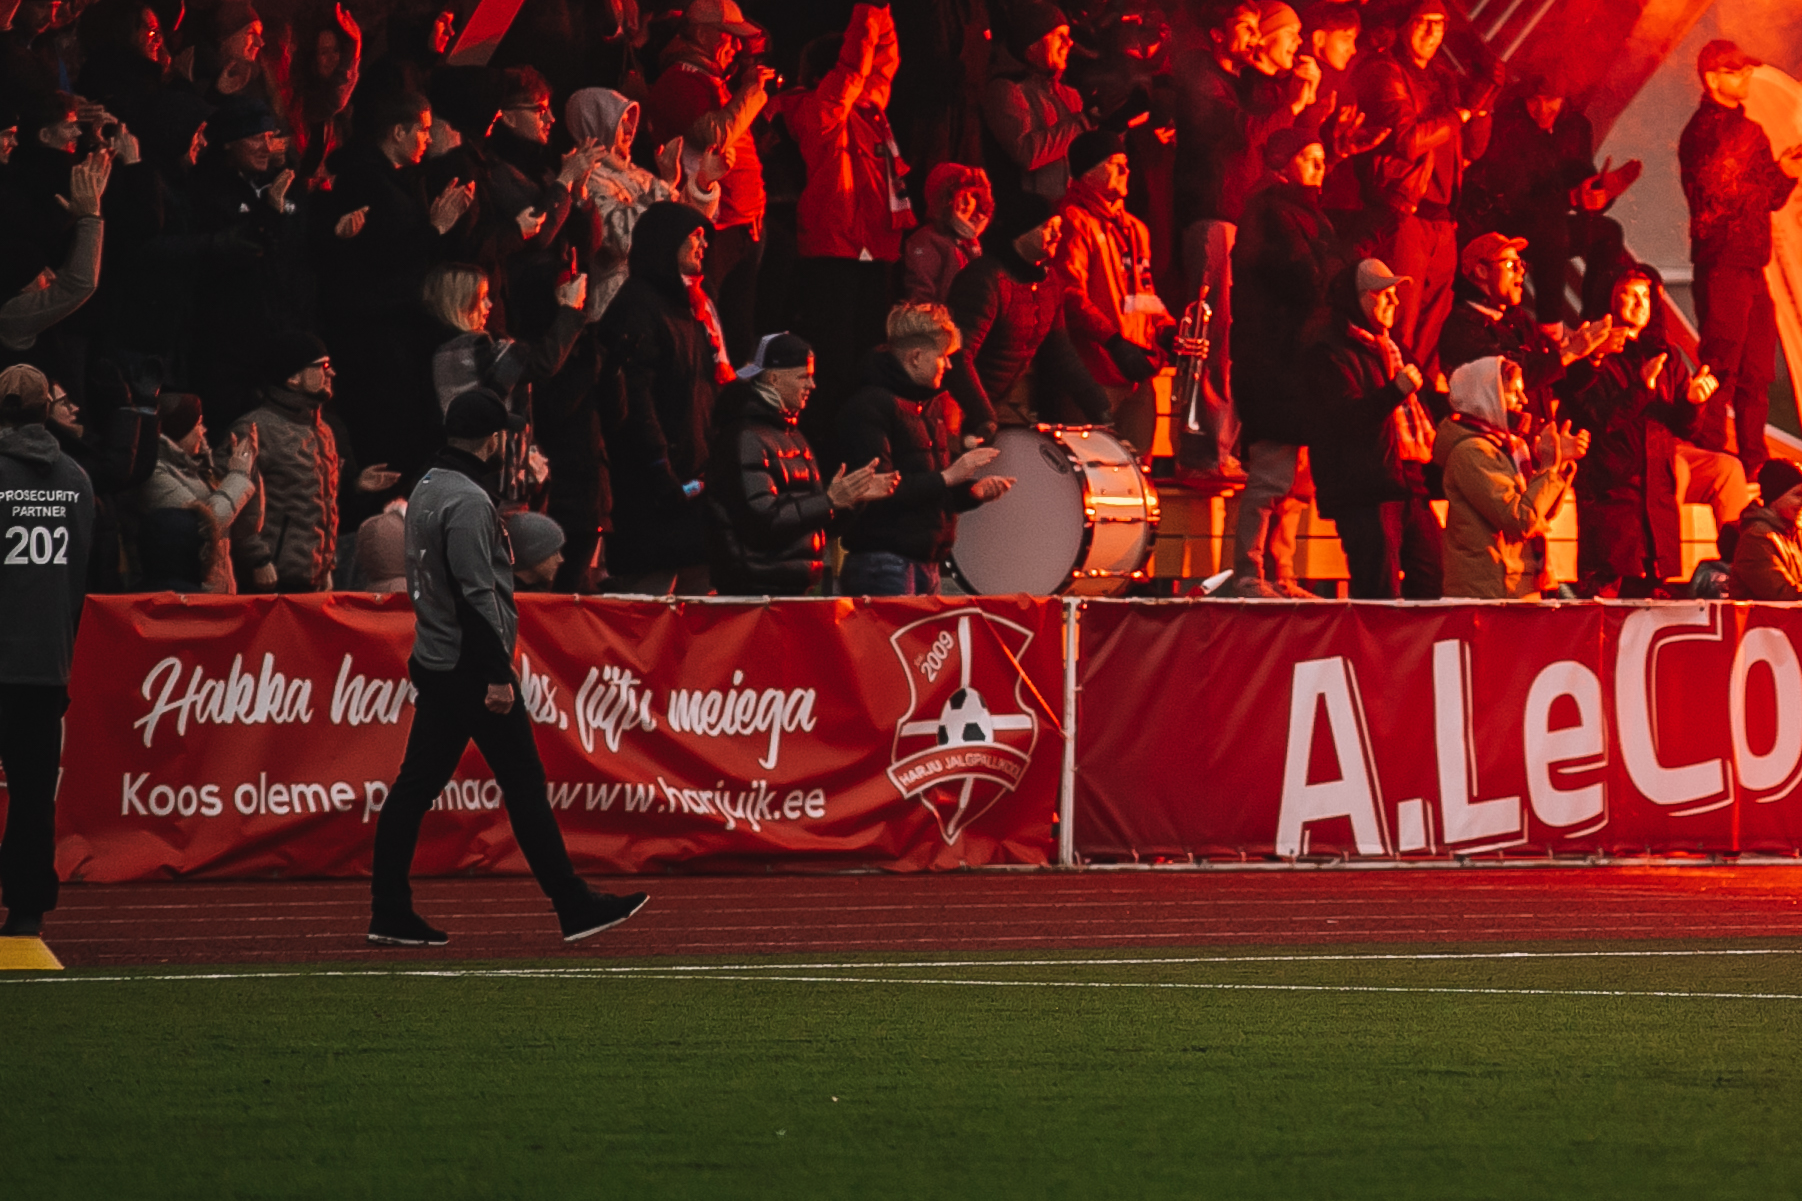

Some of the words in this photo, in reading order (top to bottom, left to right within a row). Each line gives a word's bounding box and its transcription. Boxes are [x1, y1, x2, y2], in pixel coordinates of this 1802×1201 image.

[0, 489, 80, 503] PROSECURITY
[12, 505, 67, 519] PARTNER
[3, 525, 69, 565] 202
[920, 630, 954, 683] 2009
[134, 652, 313, 748] Hakka
[668, 670, 818, 770] meiega
[898, 759, 944, 786] HARJU
[121, 772, 222, 817] Koos
[234, 772, 355, 817] oleme
